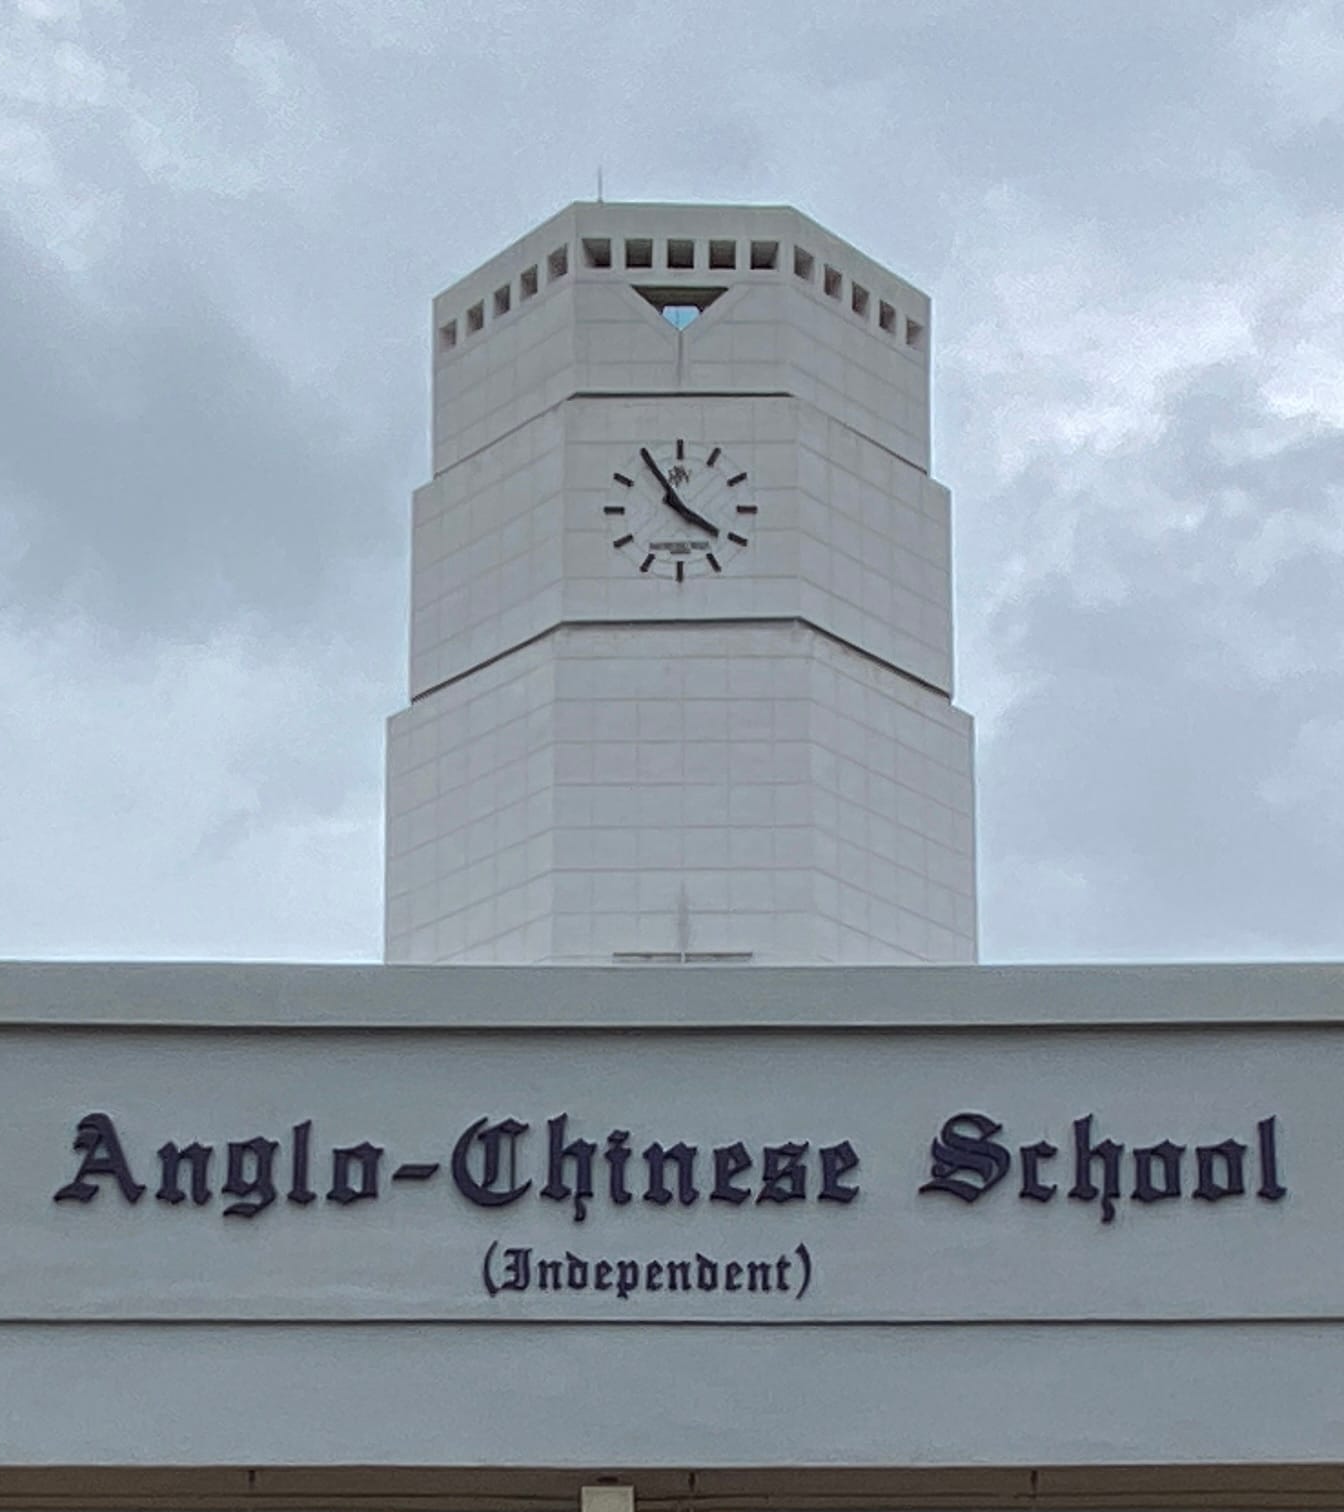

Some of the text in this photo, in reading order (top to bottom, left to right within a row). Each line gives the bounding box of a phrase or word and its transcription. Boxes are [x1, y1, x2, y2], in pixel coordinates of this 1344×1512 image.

[56, 1111, 1288, 1222] Anglo-Chinese School
[483, 1243, 813, 1297] (Independent)
